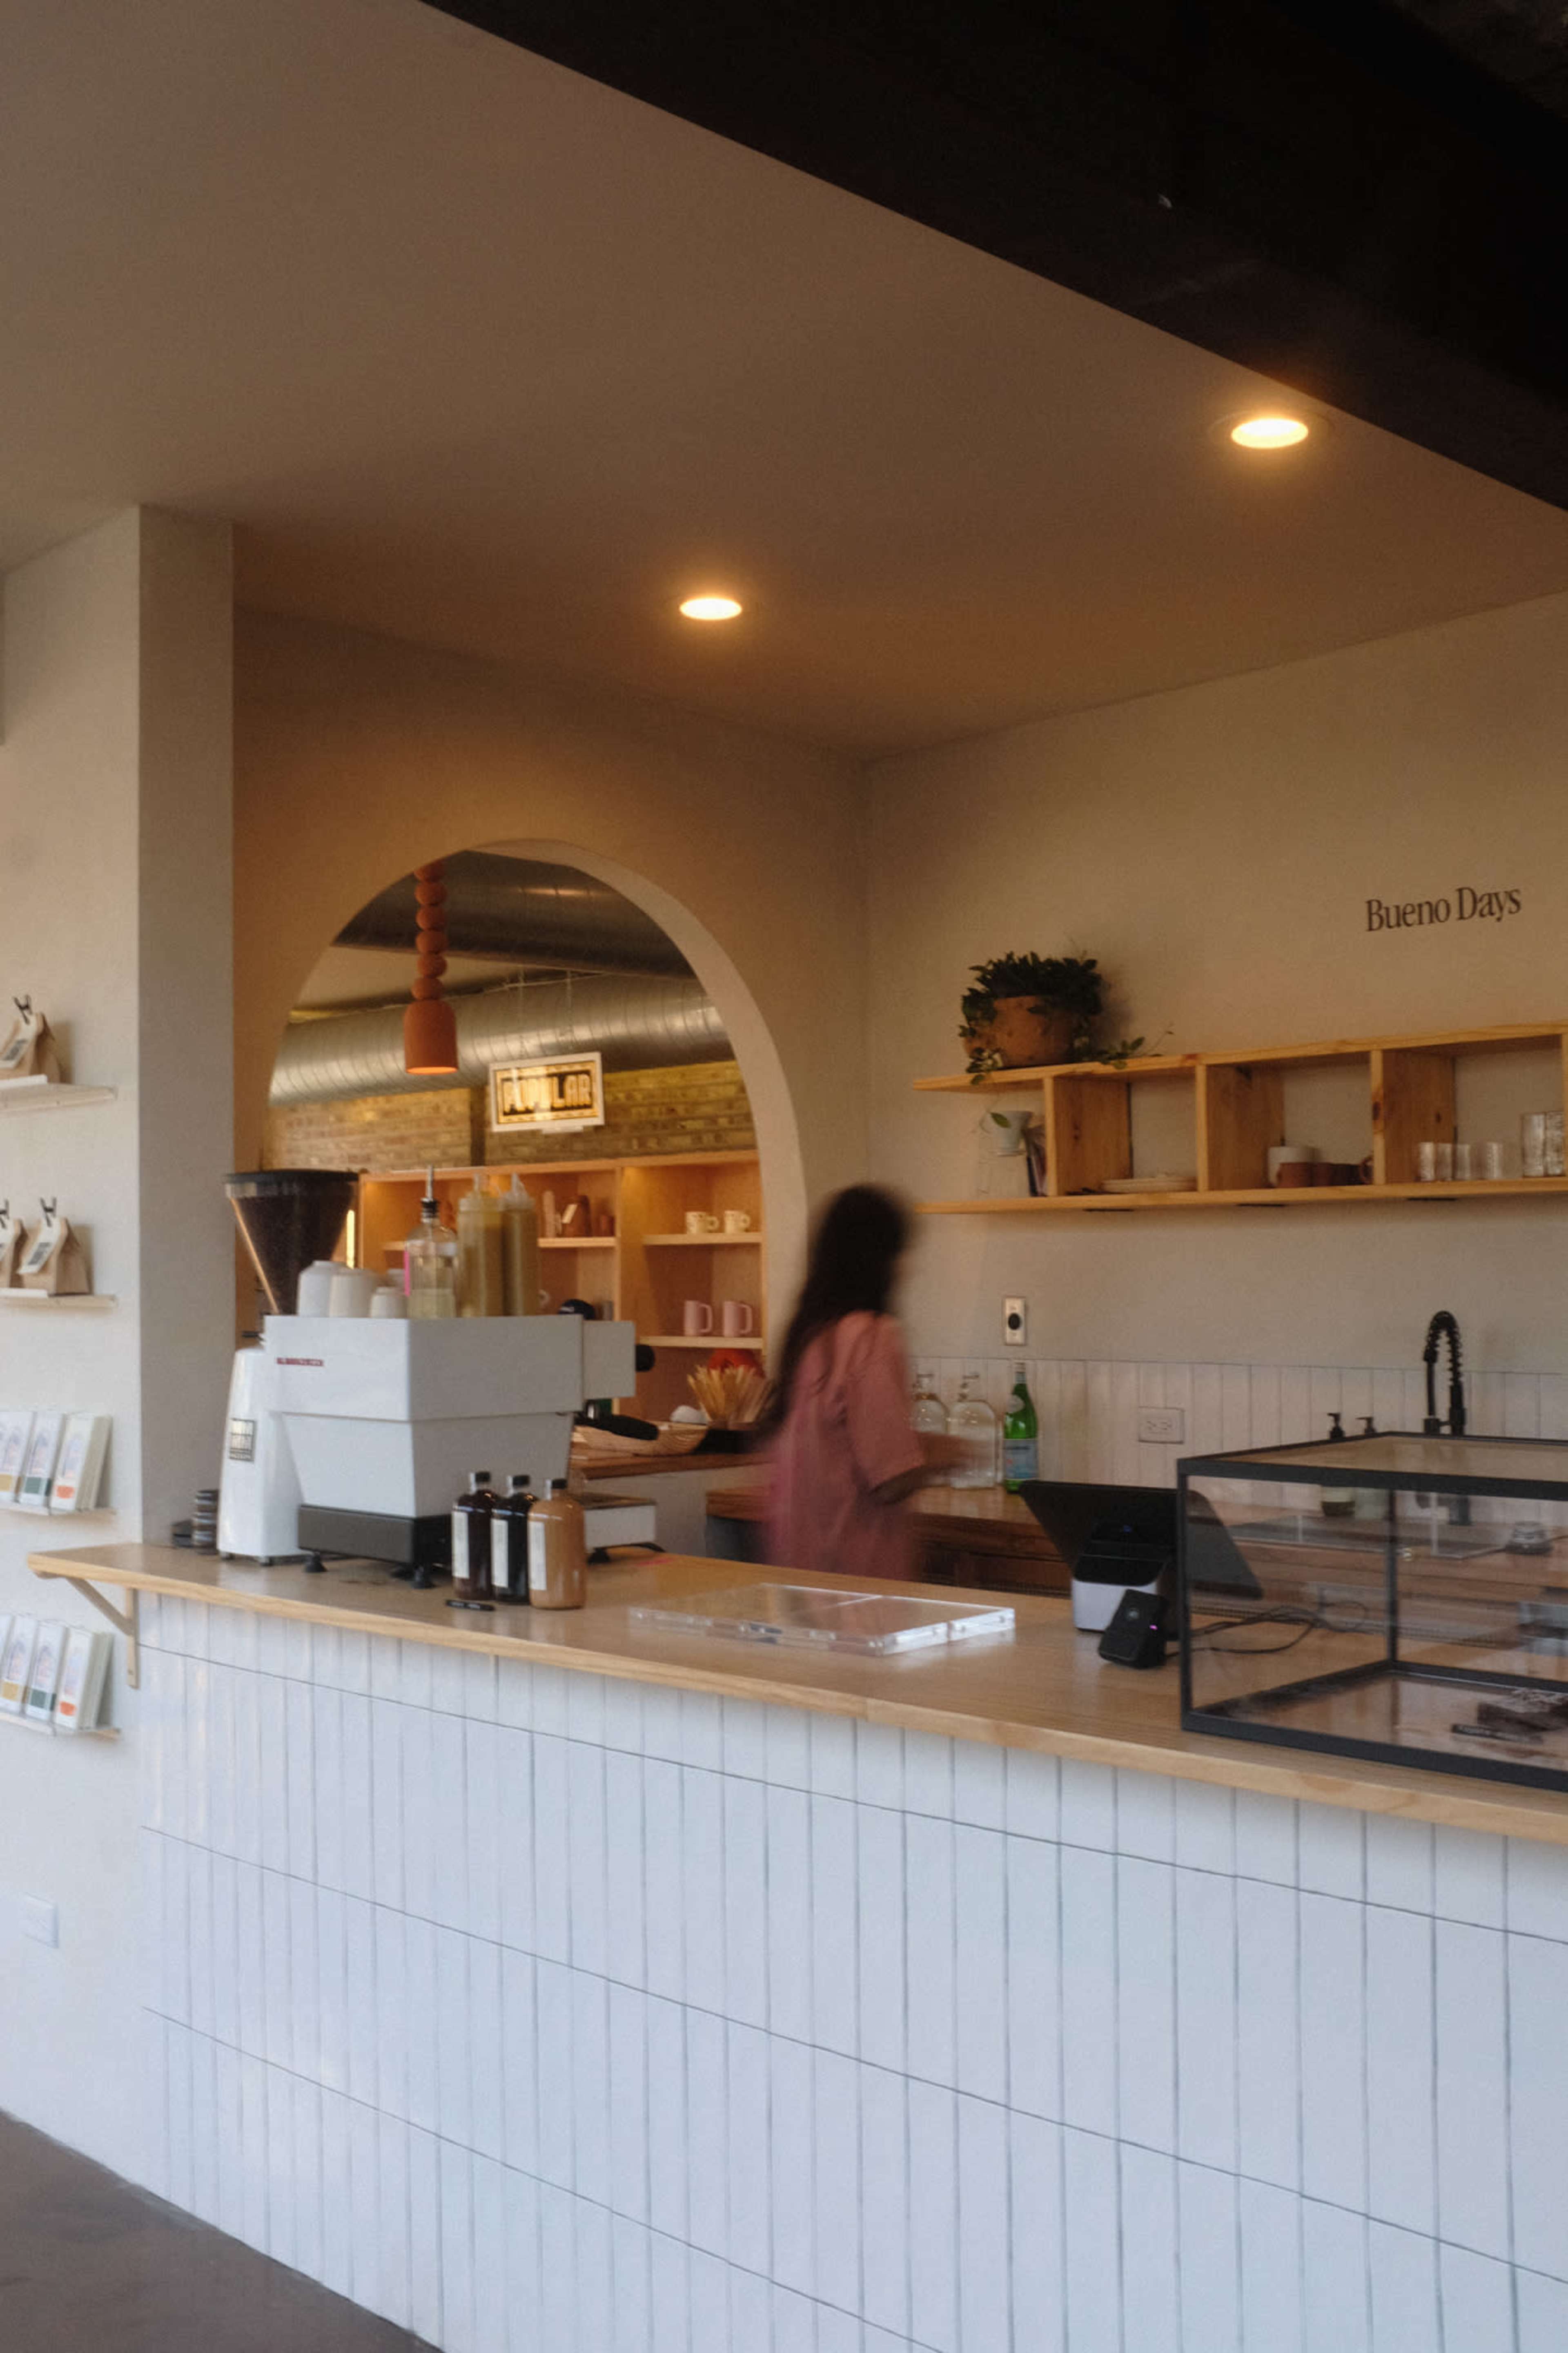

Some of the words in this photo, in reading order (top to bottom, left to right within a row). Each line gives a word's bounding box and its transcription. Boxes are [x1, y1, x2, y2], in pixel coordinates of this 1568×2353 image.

[1365, 899, 1451, 931] Bueno
[1455, 887, 1521, 922] Days
[503, 1073, 592, 1113] POLAR
